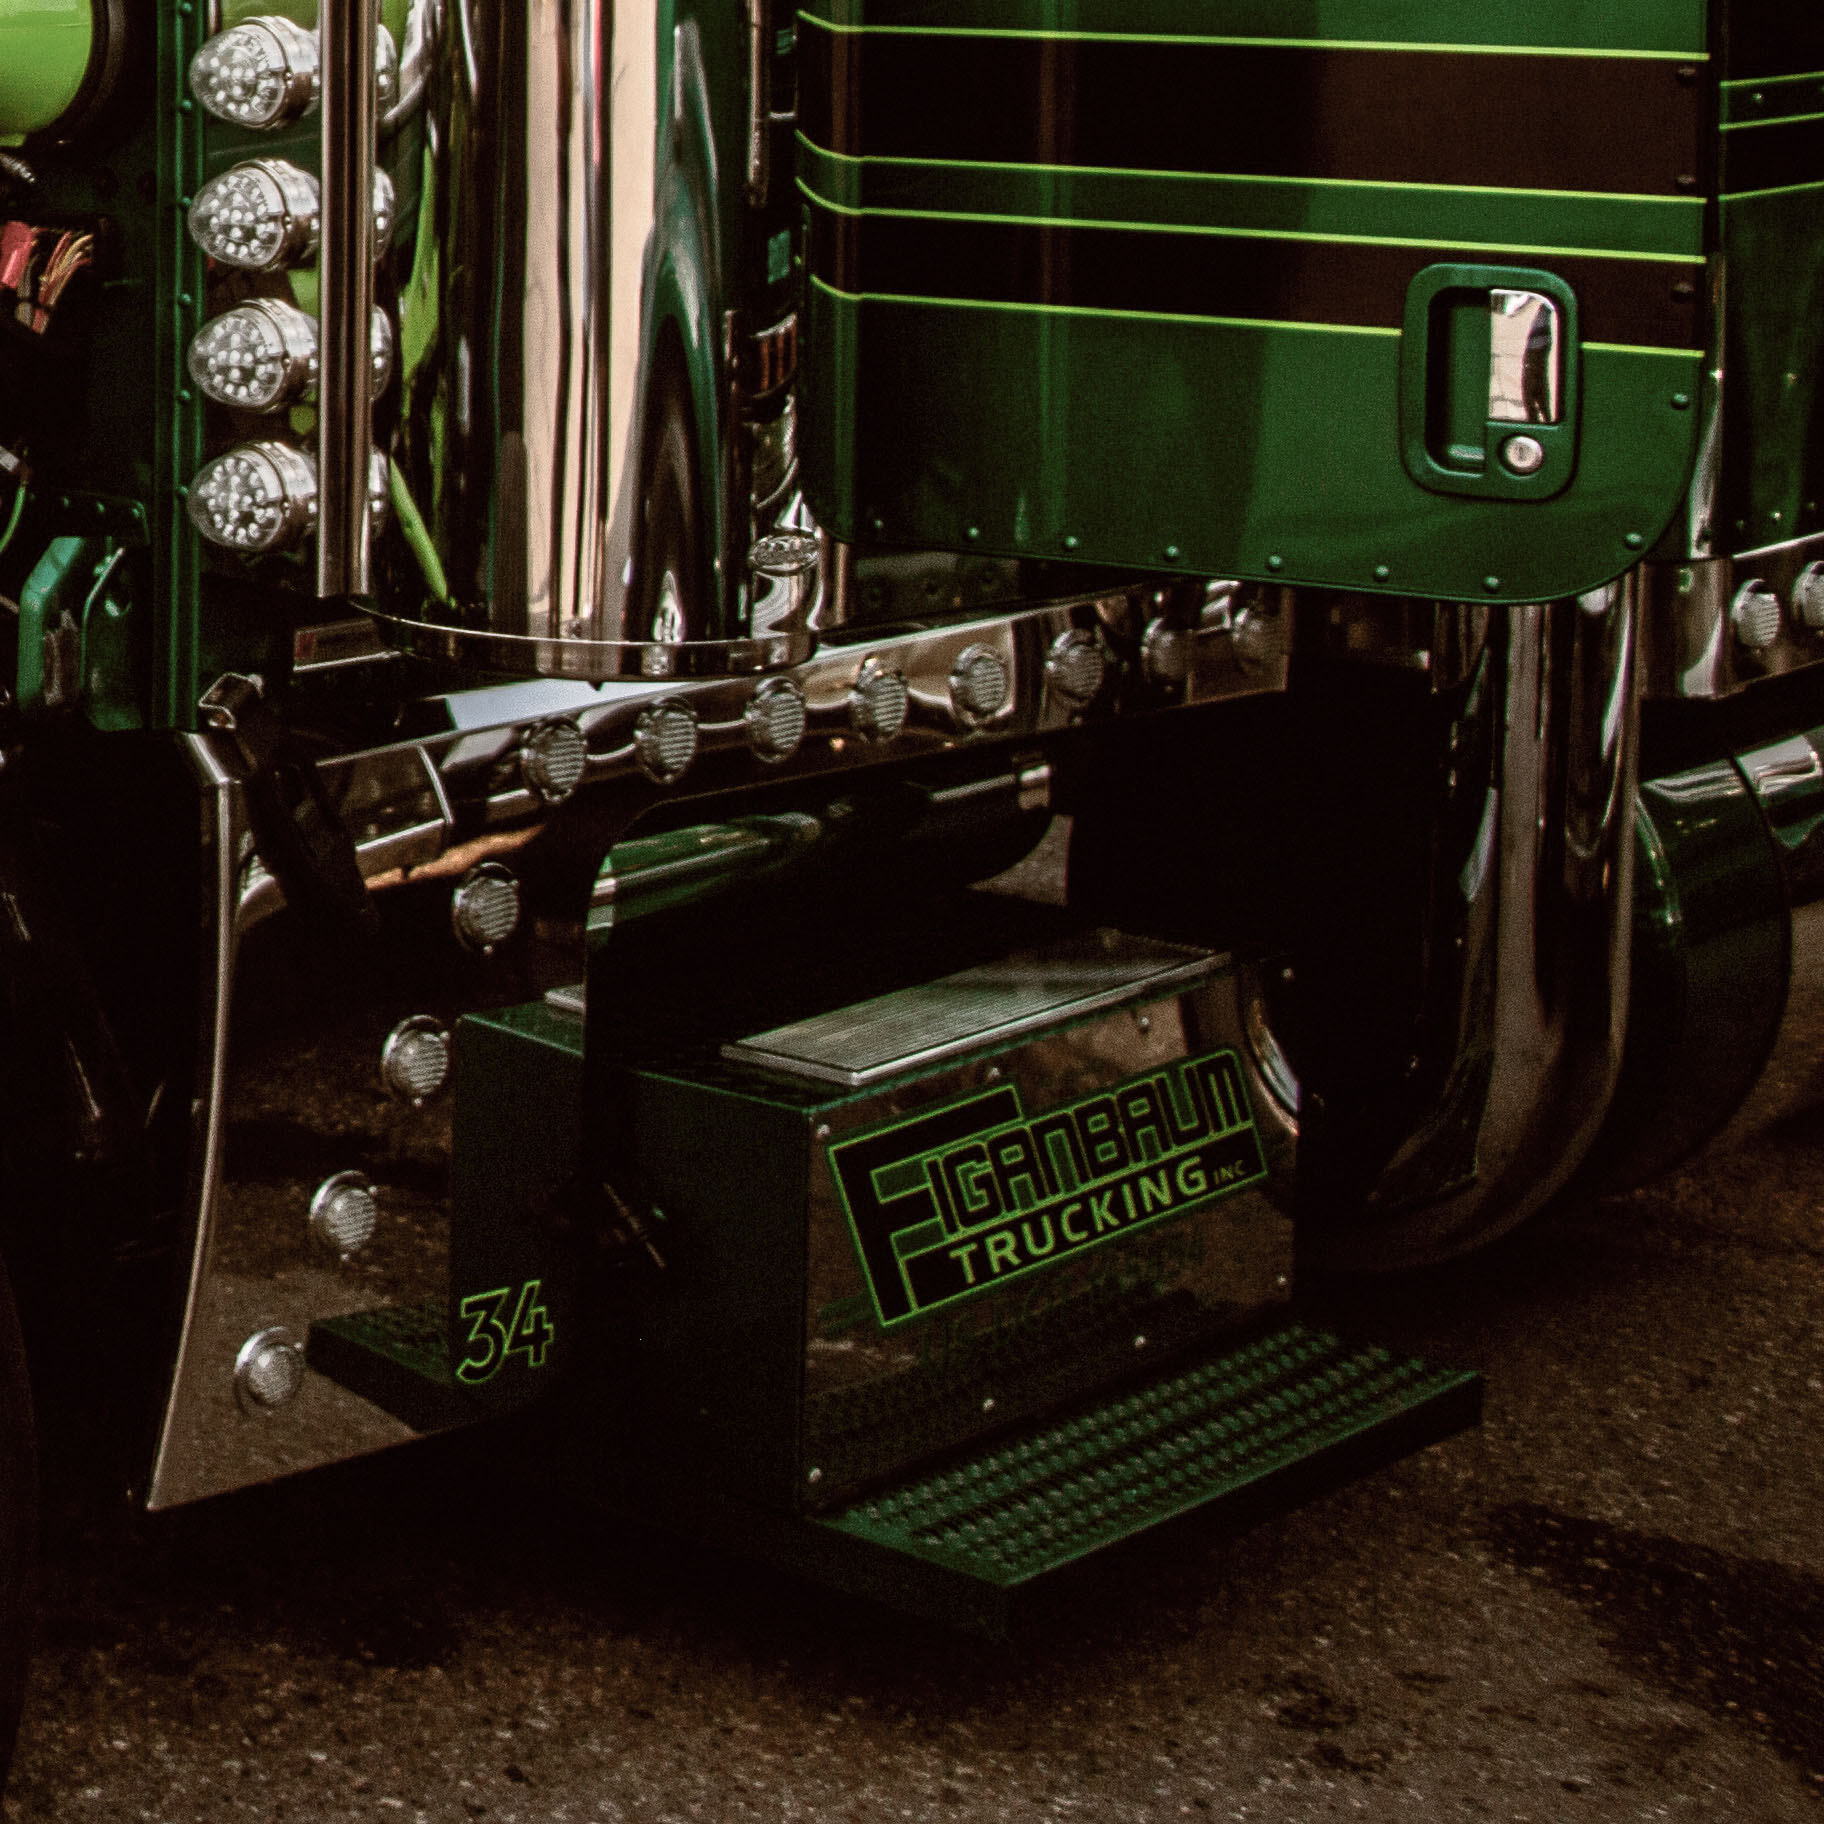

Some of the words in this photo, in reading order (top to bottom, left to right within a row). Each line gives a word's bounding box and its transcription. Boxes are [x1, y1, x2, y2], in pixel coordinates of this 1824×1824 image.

[948, 1155, 1210, 1285] TRUCKING
[1212, 1158, 1248, 1186] INC
[453, 1278, 555, 1386] 34
